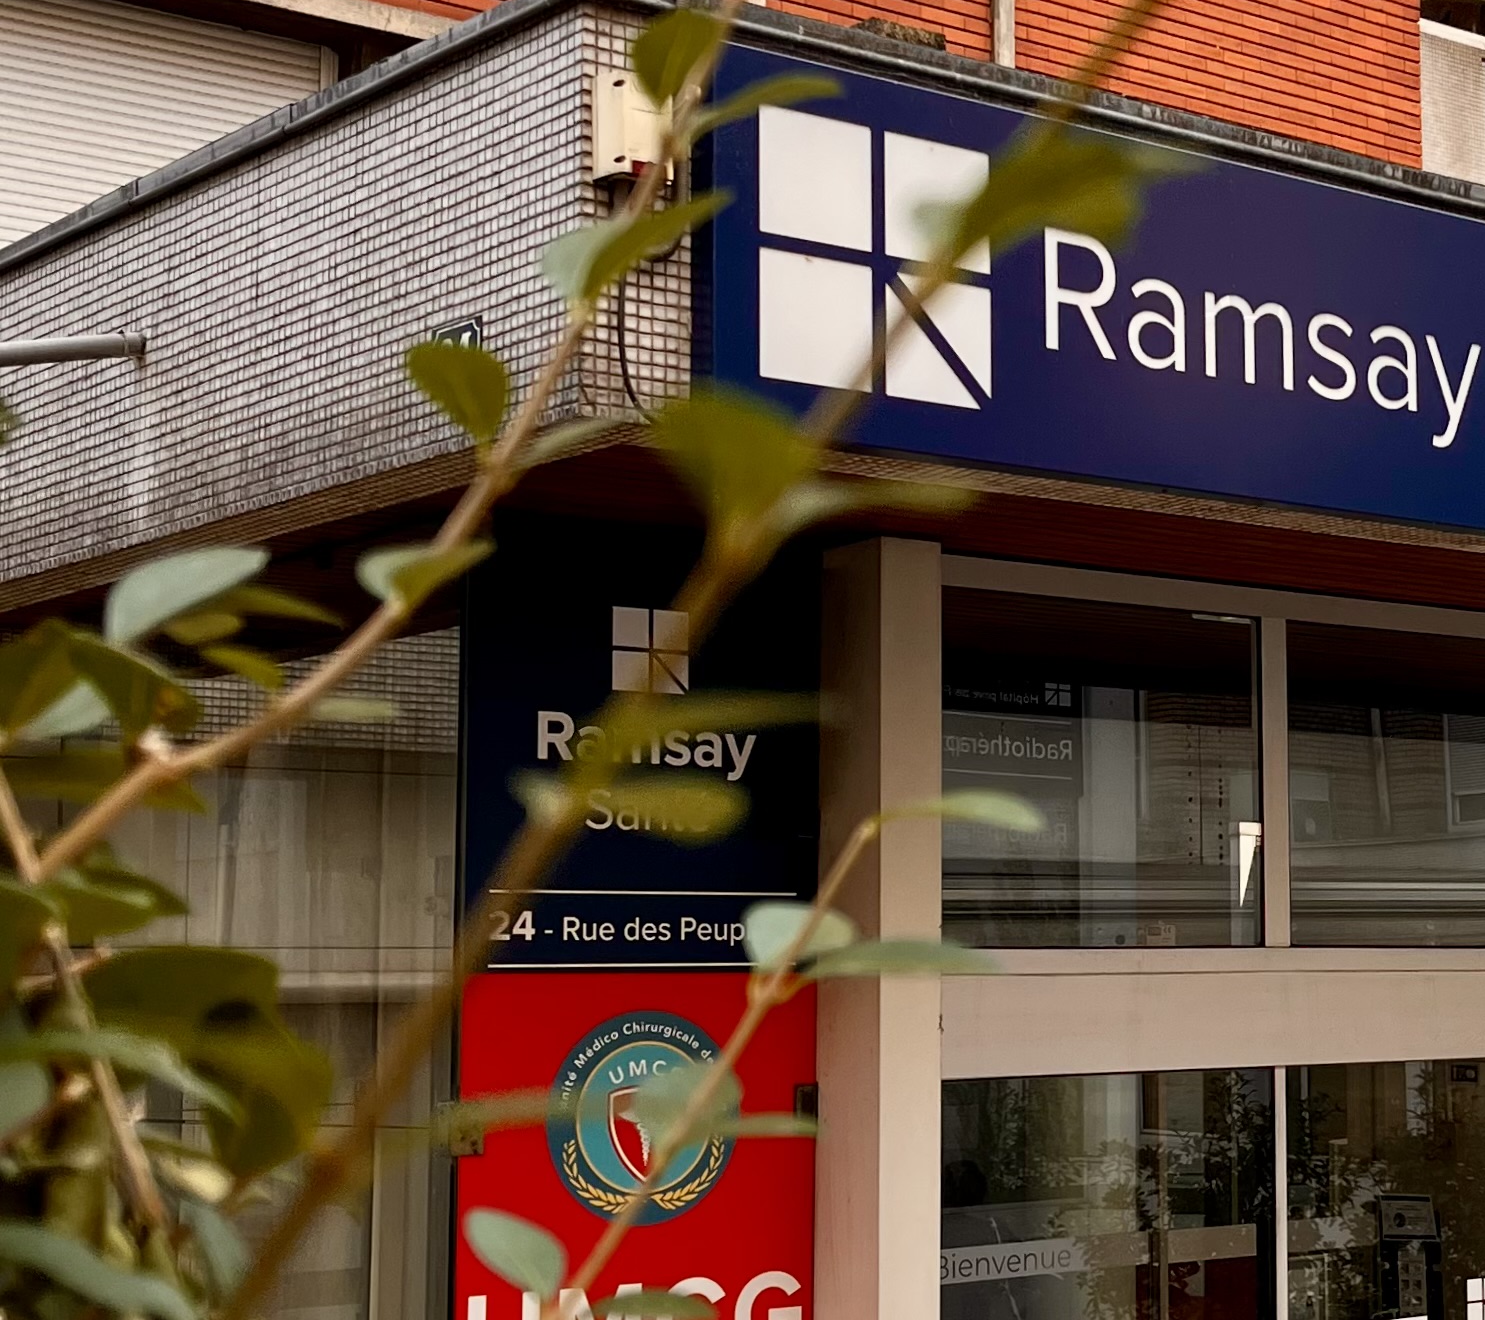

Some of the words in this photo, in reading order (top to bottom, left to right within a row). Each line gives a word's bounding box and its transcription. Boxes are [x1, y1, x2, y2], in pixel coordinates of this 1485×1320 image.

[1043, 228, 1481, 449] Ramsay
[488, 911, 536, 941] 24
[562, 916, 615, 941] Rue
[624, 917, 672, 941] des
[574, 1031, 619, 1069] Médico
[622, 1022, 700, 1050] Chirurgicale
